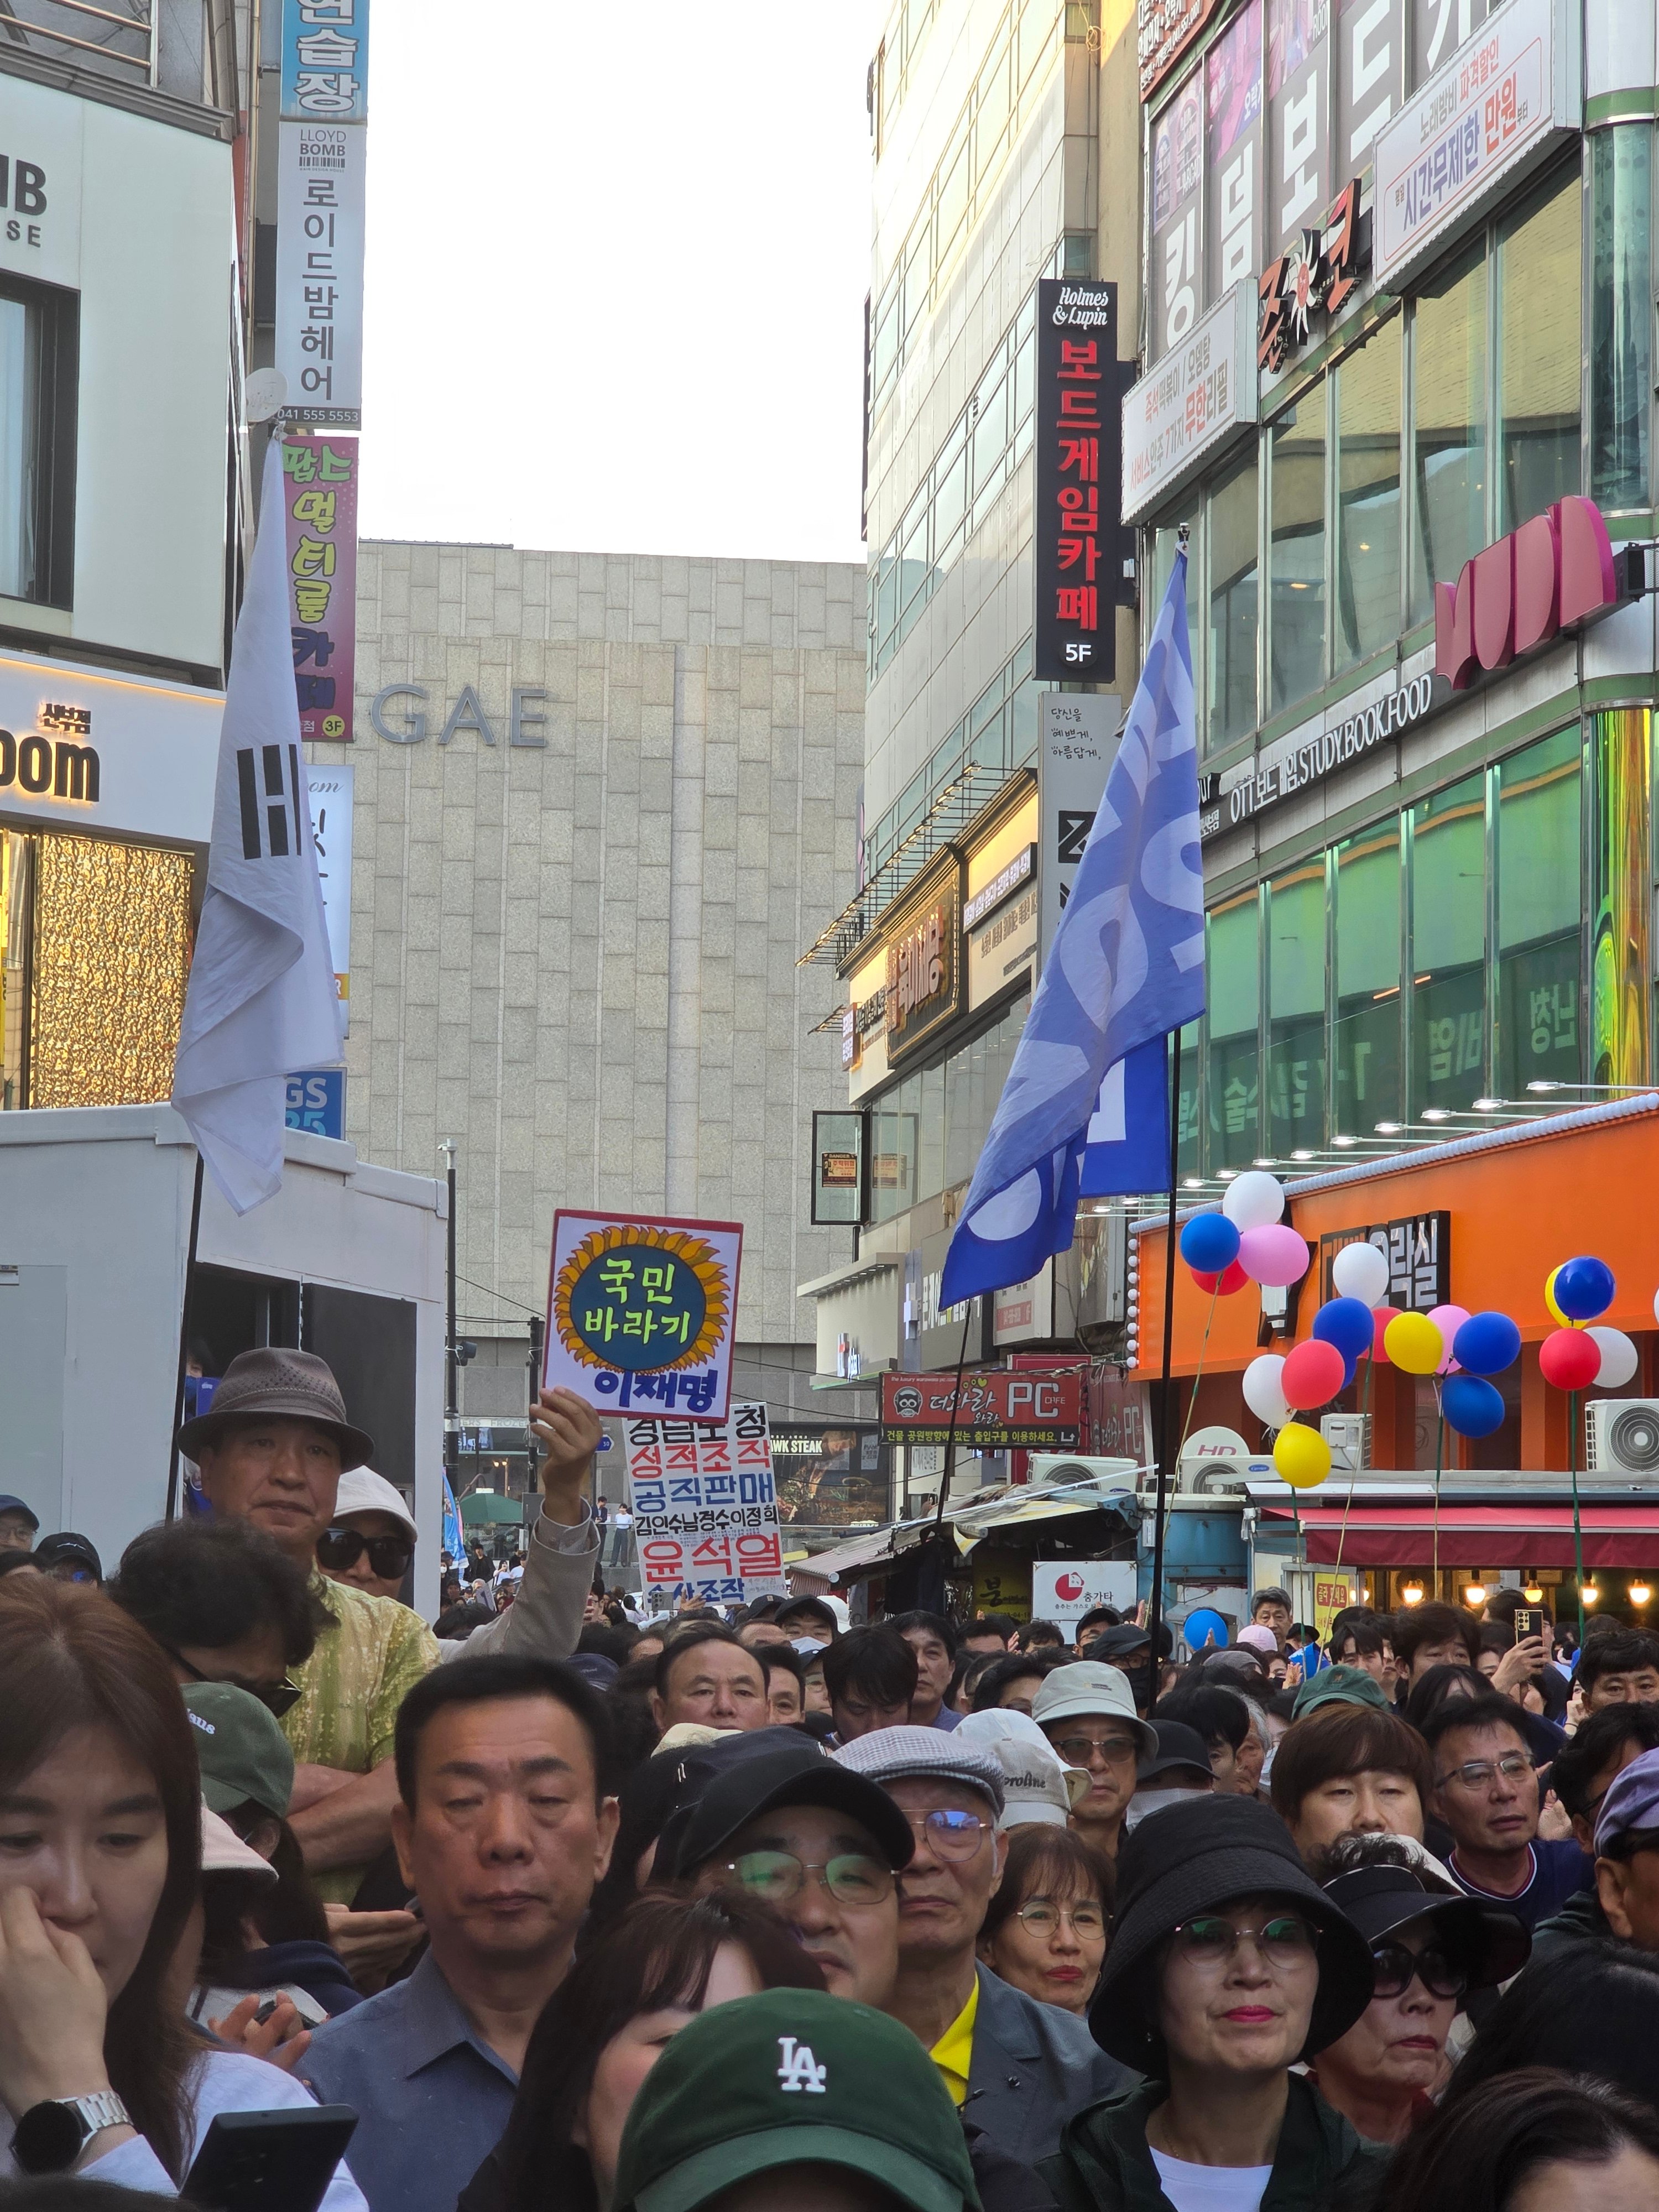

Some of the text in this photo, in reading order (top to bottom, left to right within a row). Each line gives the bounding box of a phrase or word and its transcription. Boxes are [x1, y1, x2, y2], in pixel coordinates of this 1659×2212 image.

[1420, 35, 1499, 144] 노래방비 파격할인
[300, 129, 346, 143] LLOYD
[300, 144, 346, 155] BOMB
[0, 154, 48, 216] B
[1404, 110, 1480, 231] 시간무제한
[300, 179, 339, 400] 로이드밤헤어
[1060, 286, 1109, 307] Holmes
[1188, 332, 1211, 385] 오뎅탕
[278, 409, 358, 422] 041 555 5553
[1185, 358, 1228, 442] 무한리필
[1056, 339, 1102, 631] 보드게임카페
[1065, 644, 1092, 662] 5F
[325, 720, 342, 732] 3F
[368, 683, 546, 747] GAE
[1051, 708, 1082, 722] 당신을
[285, 1077, 328, 1108] GS
[599, 1258, 676, 1306] 국민
[585, 1307, 692, 1345] 바라기
[594, 1369, 719, 1413] 이재명
[1006, 1382, 1066, 1418] PC CAFE
[791, 1440, 823, 1453] STEAK
[886, 1430, 1057, 1443] 건물 공원방향에 있는 출입구를 이용하세요.
[630, 1439, 771, 1479] 성적조작
[633, 1473, 774, 1513] 공직판매
[643, 1532, 782, 1583] 윤석열
[1082, 1591, 1114, 1603] 춤가타
[777, 2036, 826, 2093] LA
